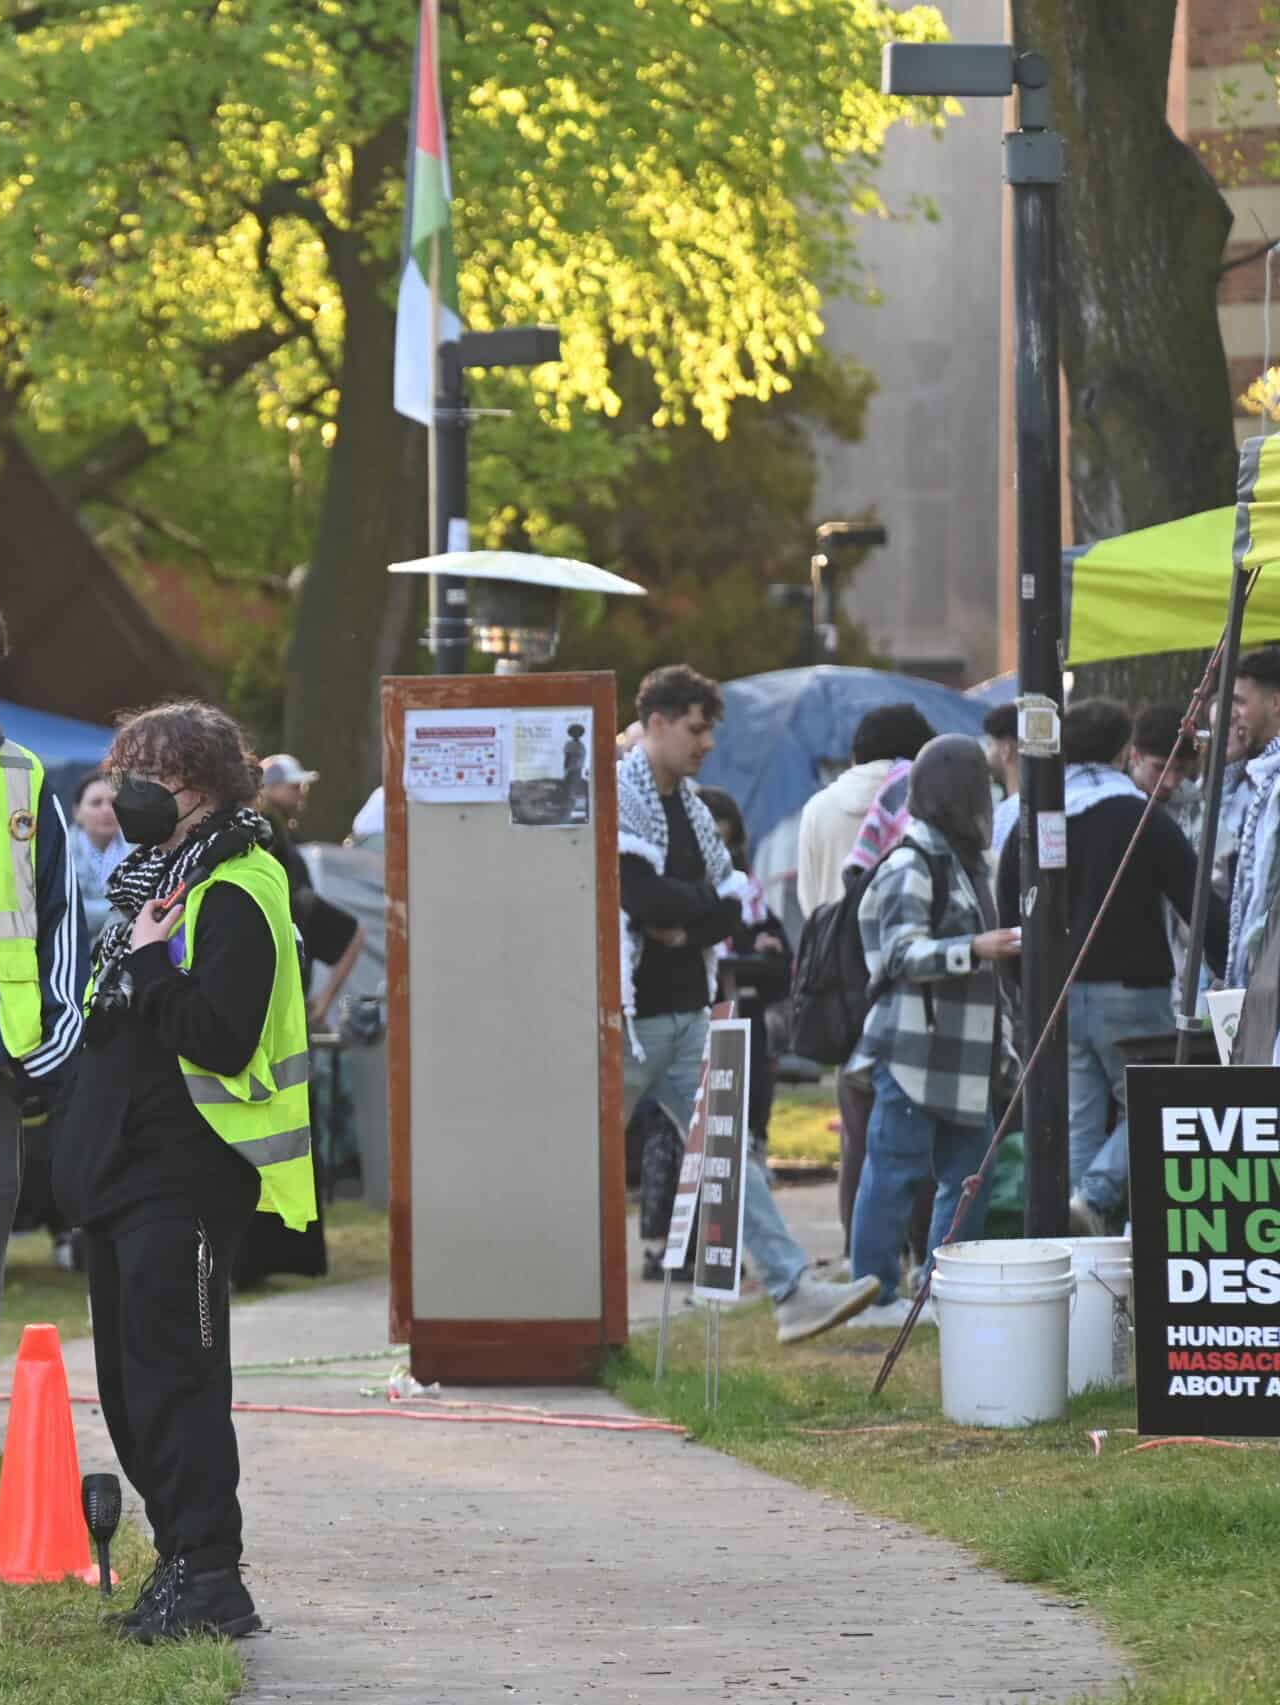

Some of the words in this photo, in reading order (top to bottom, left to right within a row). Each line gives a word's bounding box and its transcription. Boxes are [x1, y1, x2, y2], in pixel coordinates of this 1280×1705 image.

[1161, 1107, 1280, 1152] EVE
[1164, 1158, 1280, 1203] UNI
[1167, 1208, 1227, 1253] IN
[1245, 1208, 1280, 1254] G
[1167, 1259, 1280, 1304] DES
[1167, 1325, 1280, 1347] HUNDRE
[1168, 1375, 1260, 1397] ABOUT
